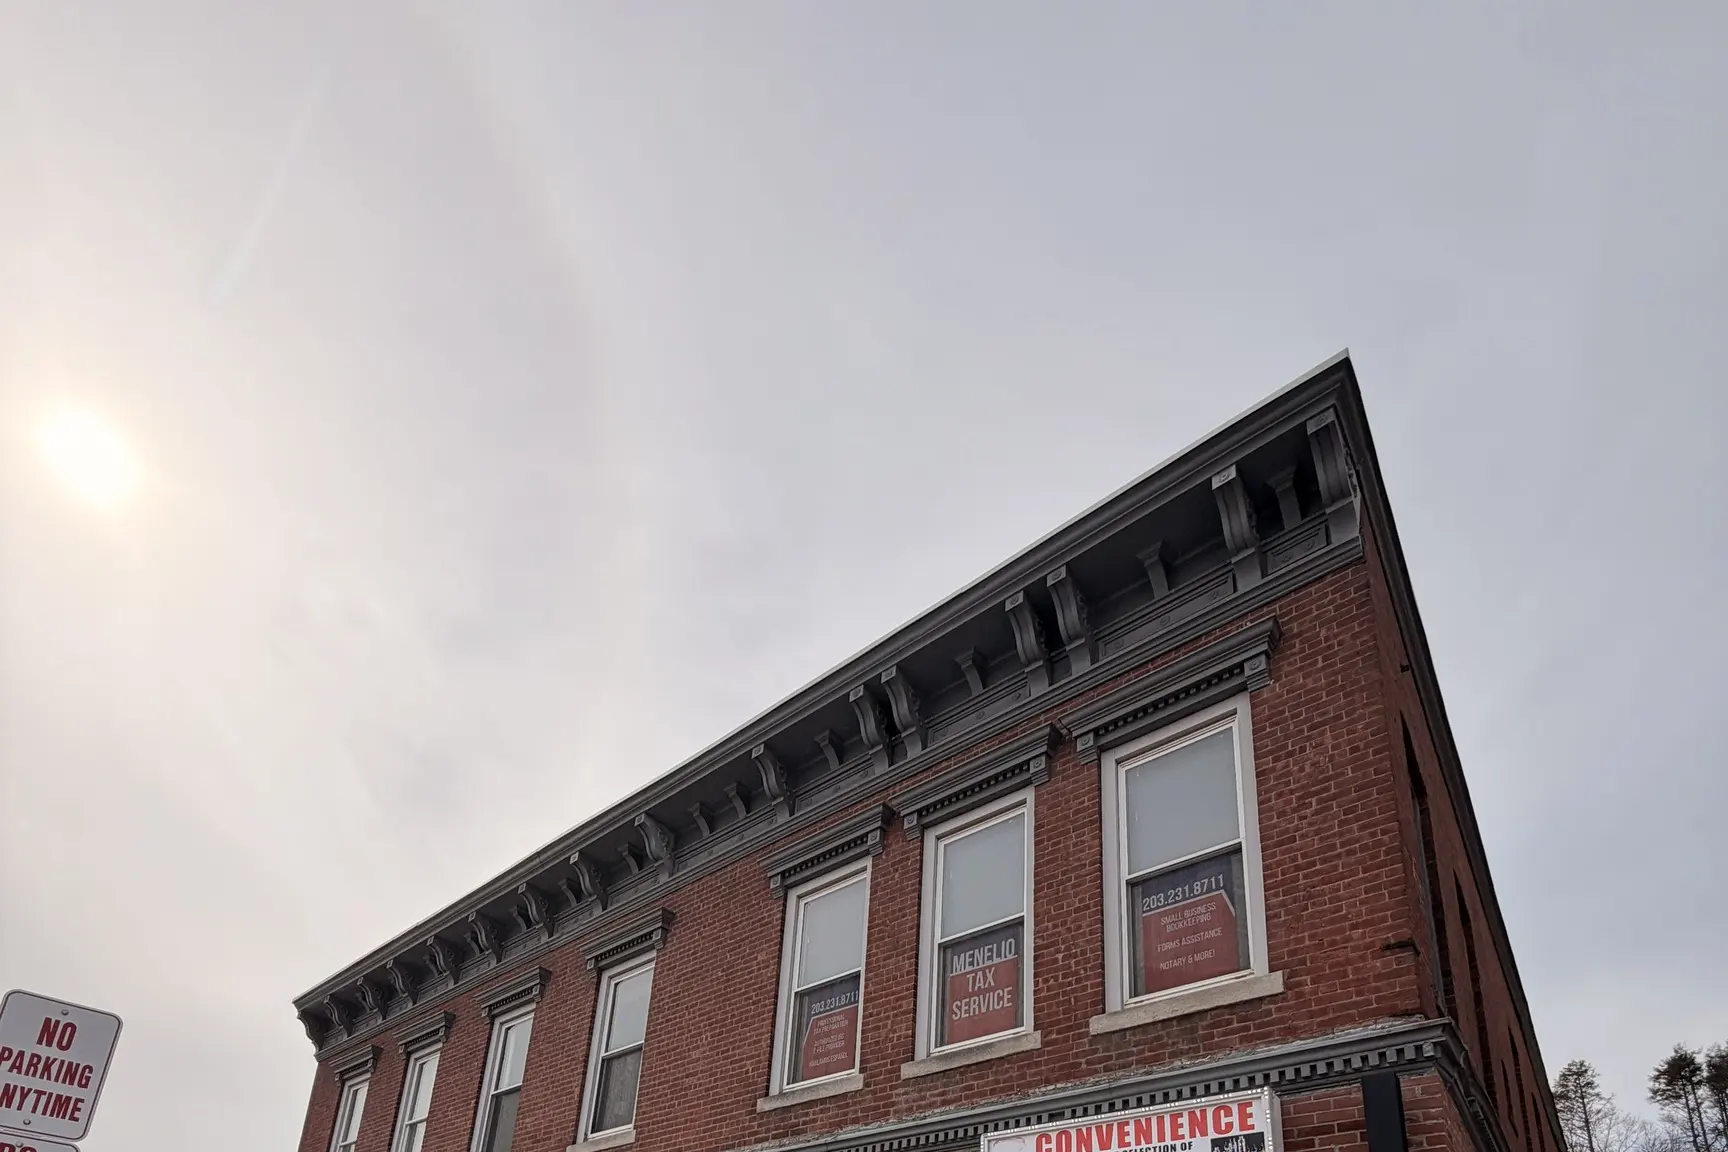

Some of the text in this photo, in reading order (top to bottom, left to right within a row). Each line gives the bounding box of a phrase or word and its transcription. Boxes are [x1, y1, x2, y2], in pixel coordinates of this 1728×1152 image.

[1143, 874, 1224, 911] 203.231.8711
[1160, 902, 1216, 926] SMALL BUSINESS
[1166, 913, 1212, 932] BOOKKEEPING
[1158, 927, 1222, 952] FORMS ASSISTANCE
[952, 938, 1016, 974] MENELIO
[1160, 949, 1216, 971] NOTARY & MORE!
[966, 967, 995, 992] TAX
[811, 990, 858, 1014] 203.231.8711
[952, 987, 1012, 1020] SERVICE
[36, 1017, 77, 1052] NO
[0, 1046, 94, 1089] PARKING
[0, 1082, 85, 1122] NYTIME
[1180, 1141, 1193, 1151] OF
